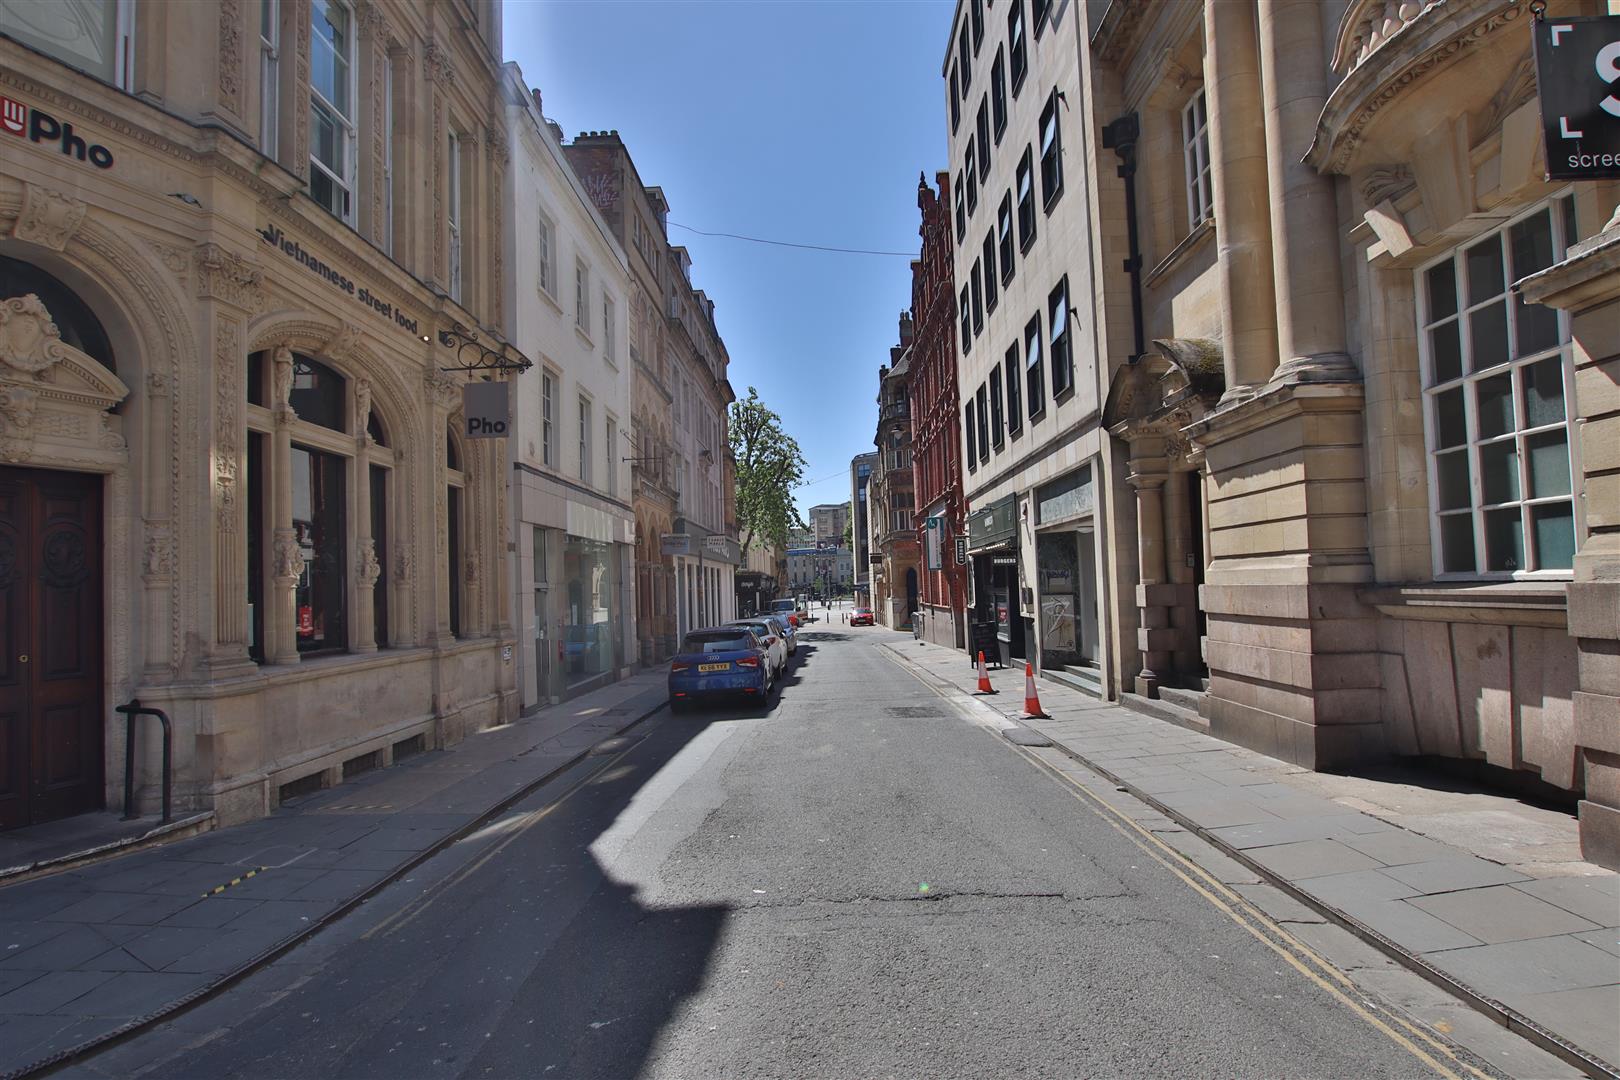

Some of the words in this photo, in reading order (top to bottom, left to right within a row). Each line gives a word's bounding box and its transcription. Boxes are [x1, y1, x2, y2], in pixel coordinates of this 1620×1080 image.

[29, 108, 114, 169] Pho
[267, 223, 356, 294] Vietnamese
[358, 288, 393, 319] street
[394, 308, 418, 335] food
[468, 416, 506, 434] Pho
